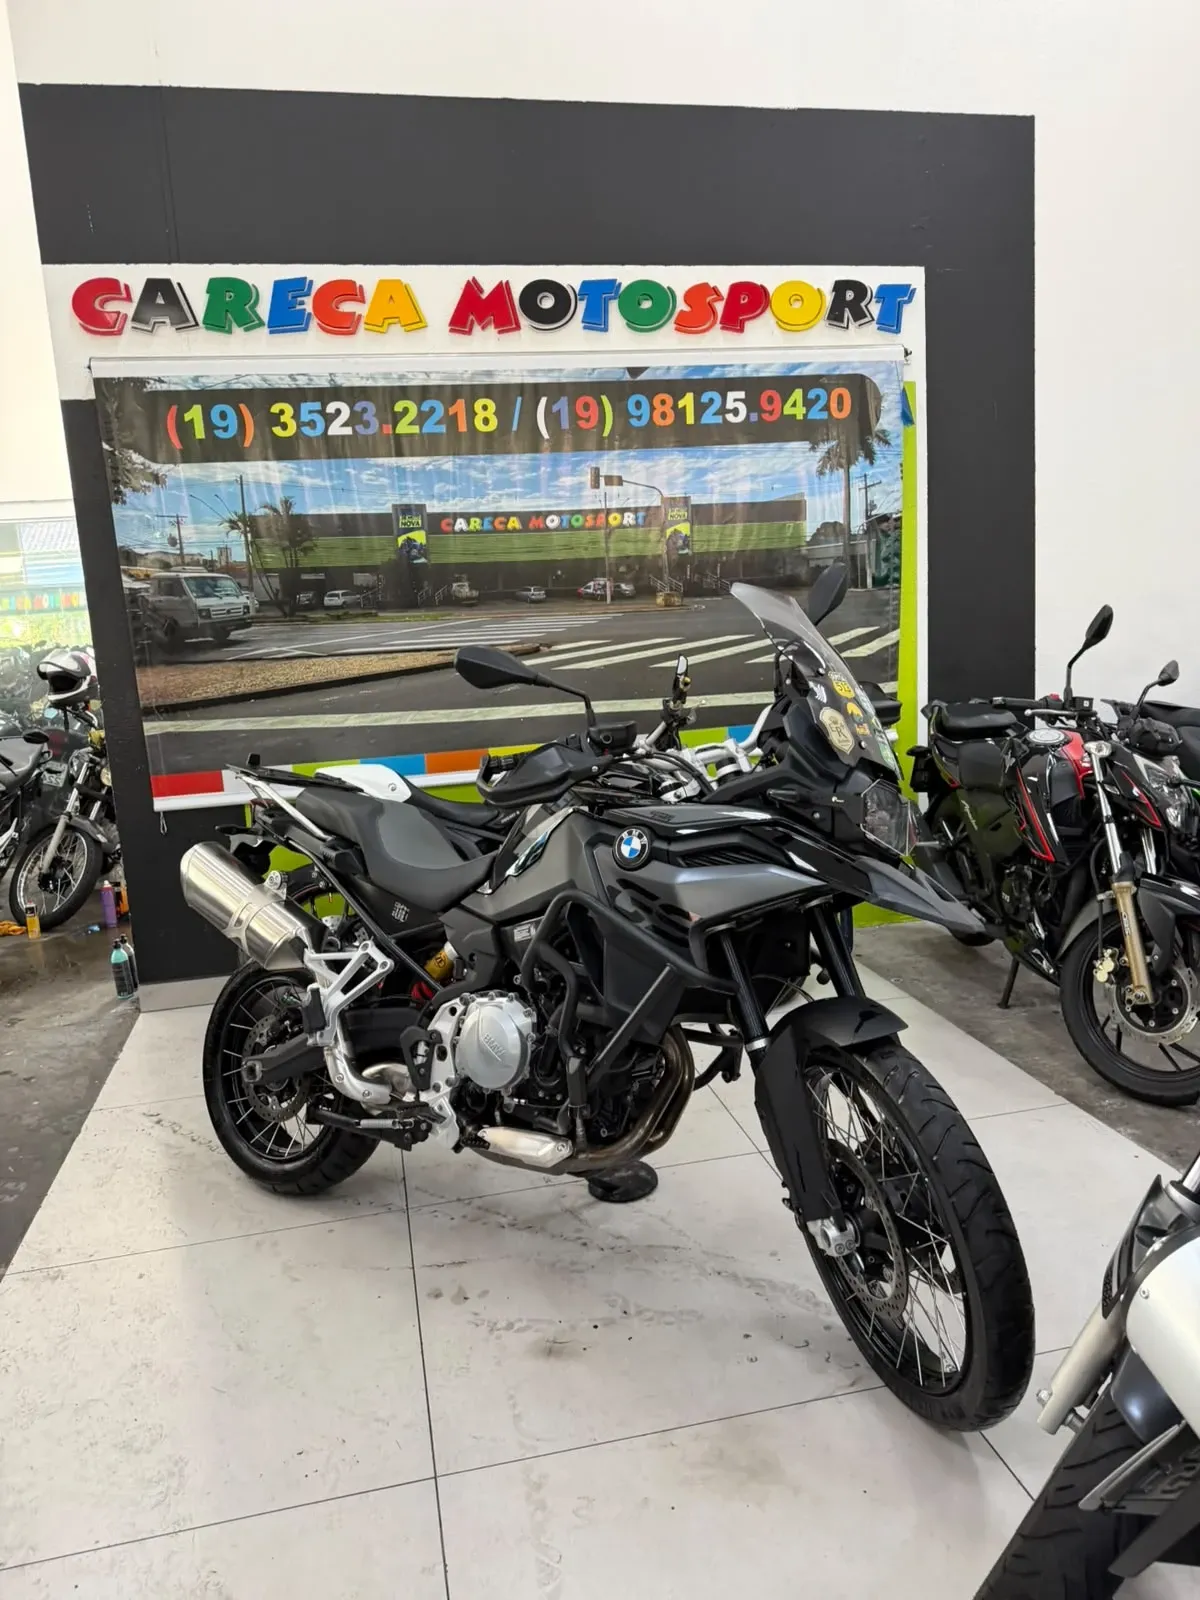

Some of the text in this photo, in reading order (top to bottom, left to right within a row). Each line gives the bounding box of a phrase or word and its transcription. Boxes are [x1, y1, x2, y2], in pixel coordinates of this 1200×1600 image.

[71, 276, 916, 335] CARECA MOTOSPORT
[166, 403, 255, 450] (19)
[271, 397, 498, 439] 3523.2218
[535, 394, 614, 440] (19)
[627, 386, 852, 431] 98125.9420
[440, 511, 646, 533] CARECA MOTOSPORT
[482, 1031, 507, 1057] BMW
